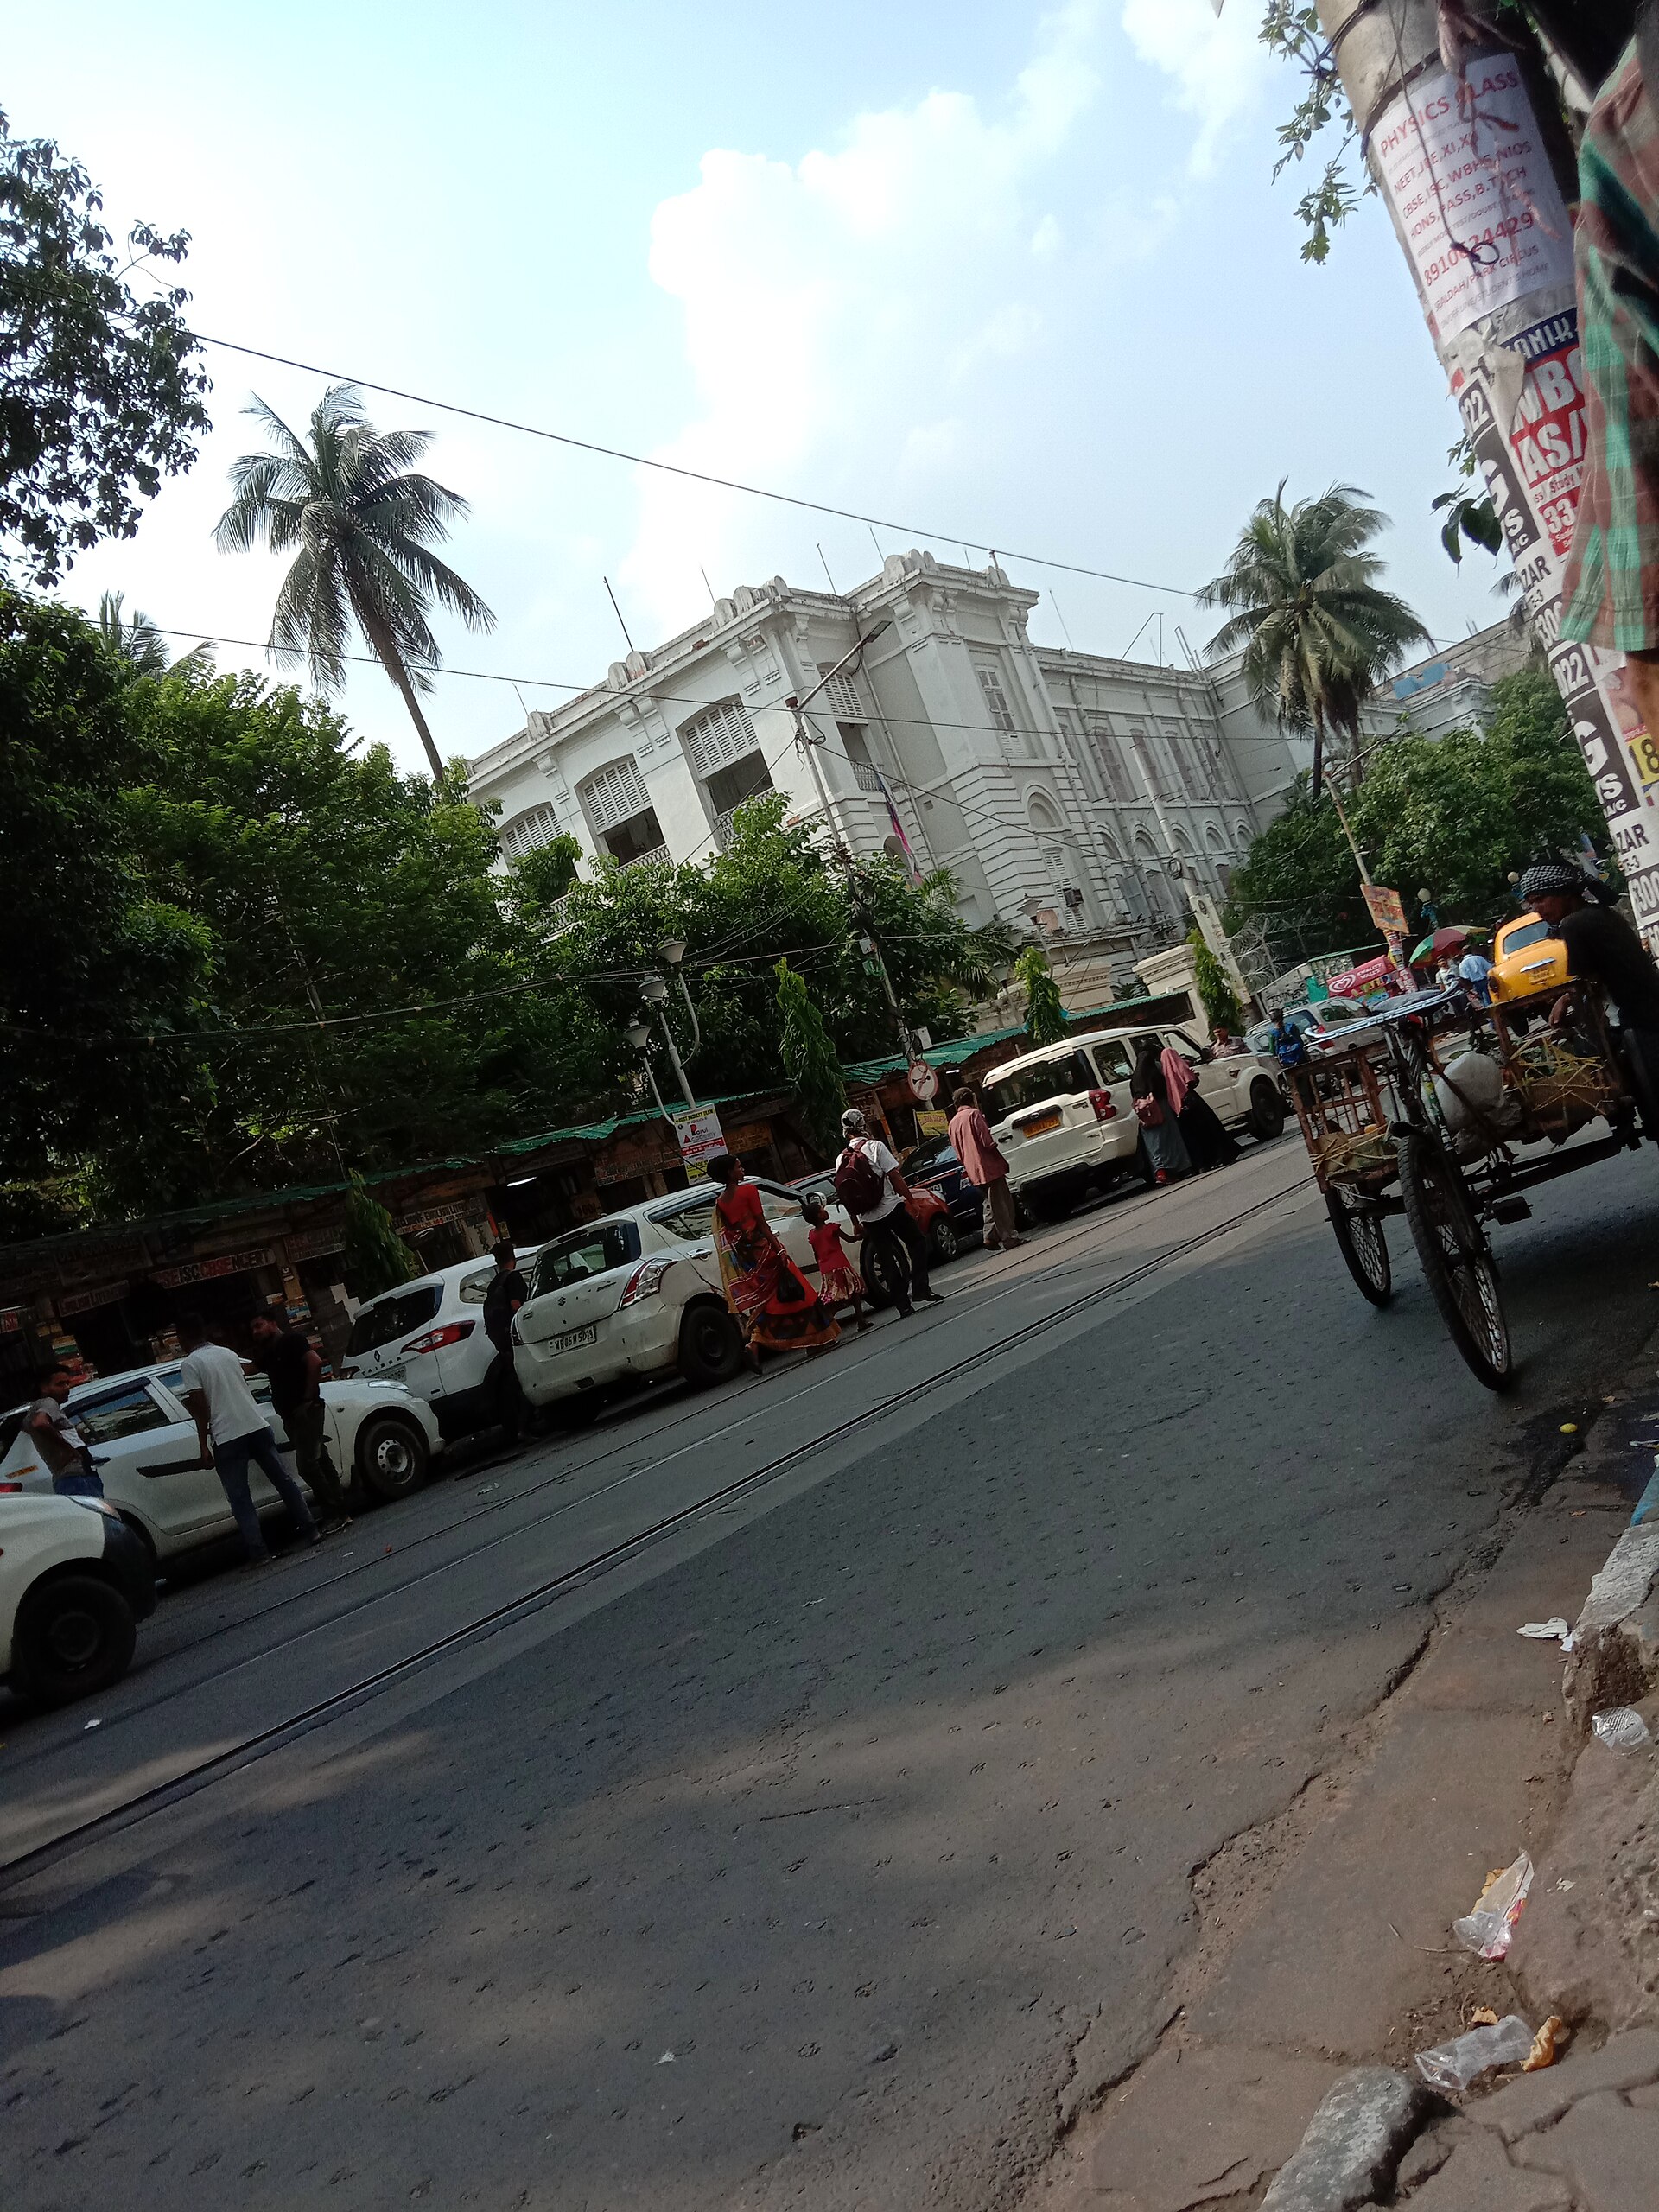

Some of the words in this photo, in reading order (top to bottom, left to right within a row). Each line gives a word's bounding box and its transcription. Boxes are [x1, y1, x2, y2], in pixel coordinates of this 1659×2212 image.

[1380, 95, 1450, 156] PHYSICS
[1357, 963, 1382, 976] KWALITY
[683, 1132, 716, 1144] Academy
